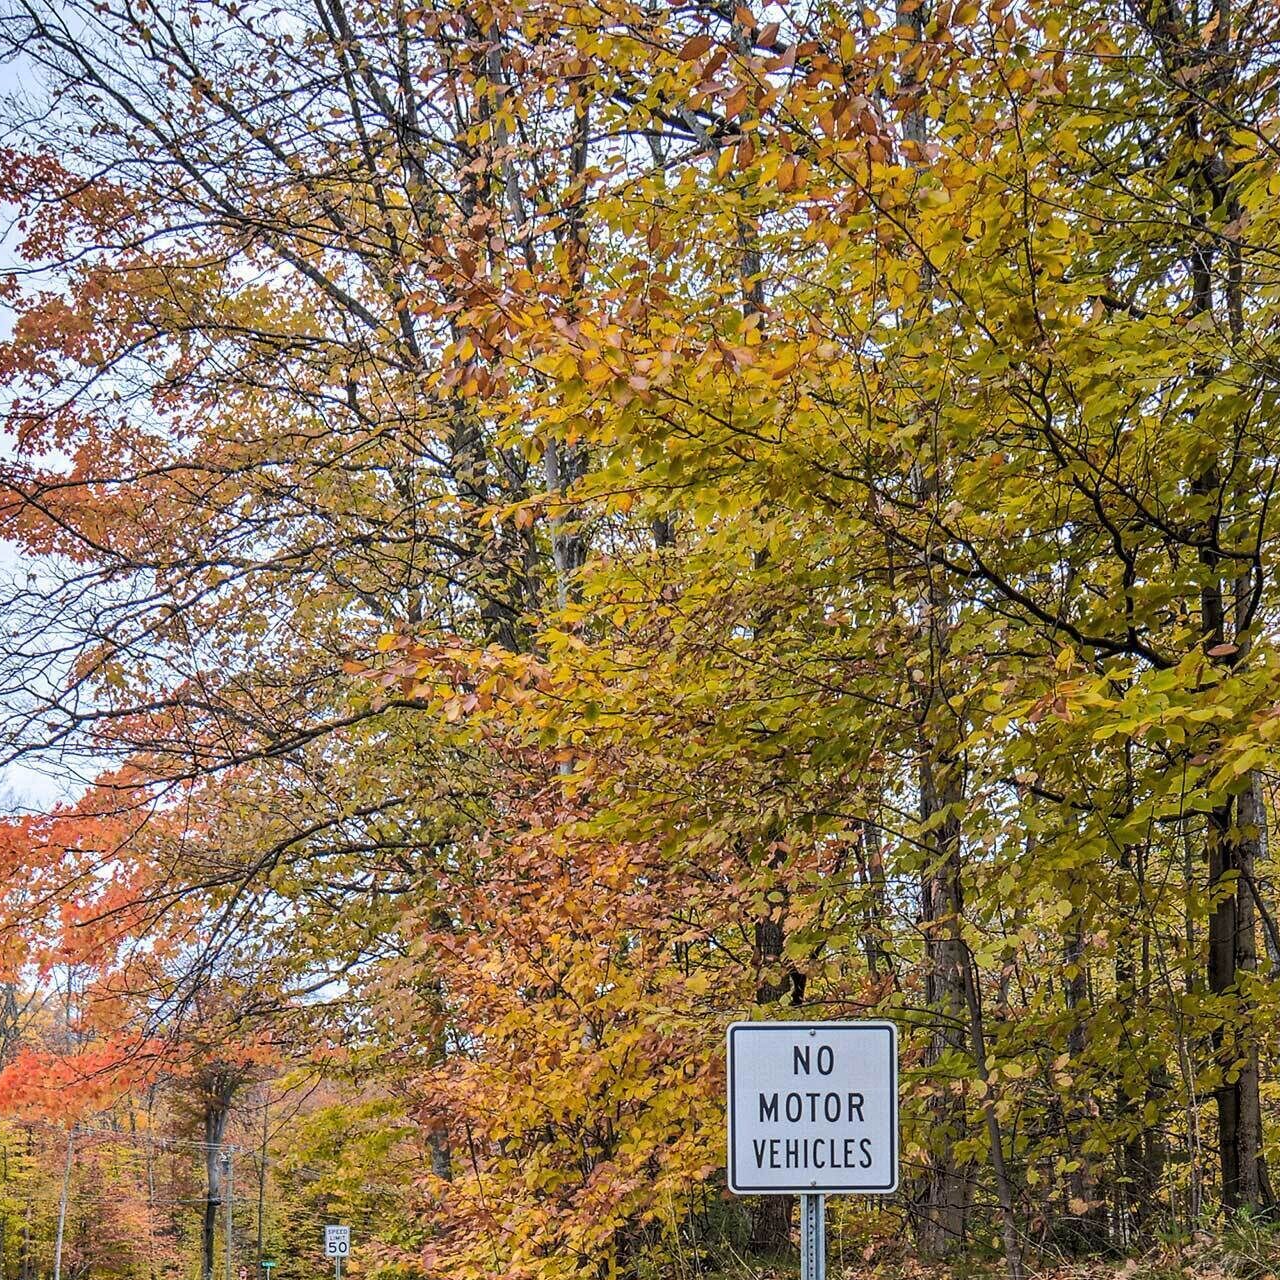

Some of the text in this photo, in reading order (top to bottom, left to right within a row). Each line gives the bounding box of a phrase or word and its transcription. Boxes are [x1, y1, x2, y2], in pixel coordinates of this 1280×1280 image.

[793, 1045, 834, 1075] NO
[759, 1092, 865, 1122] MOTOR
[753, 1138, 872, 1169] VEHICLES
[328, 1241, 347, 1253] 50
